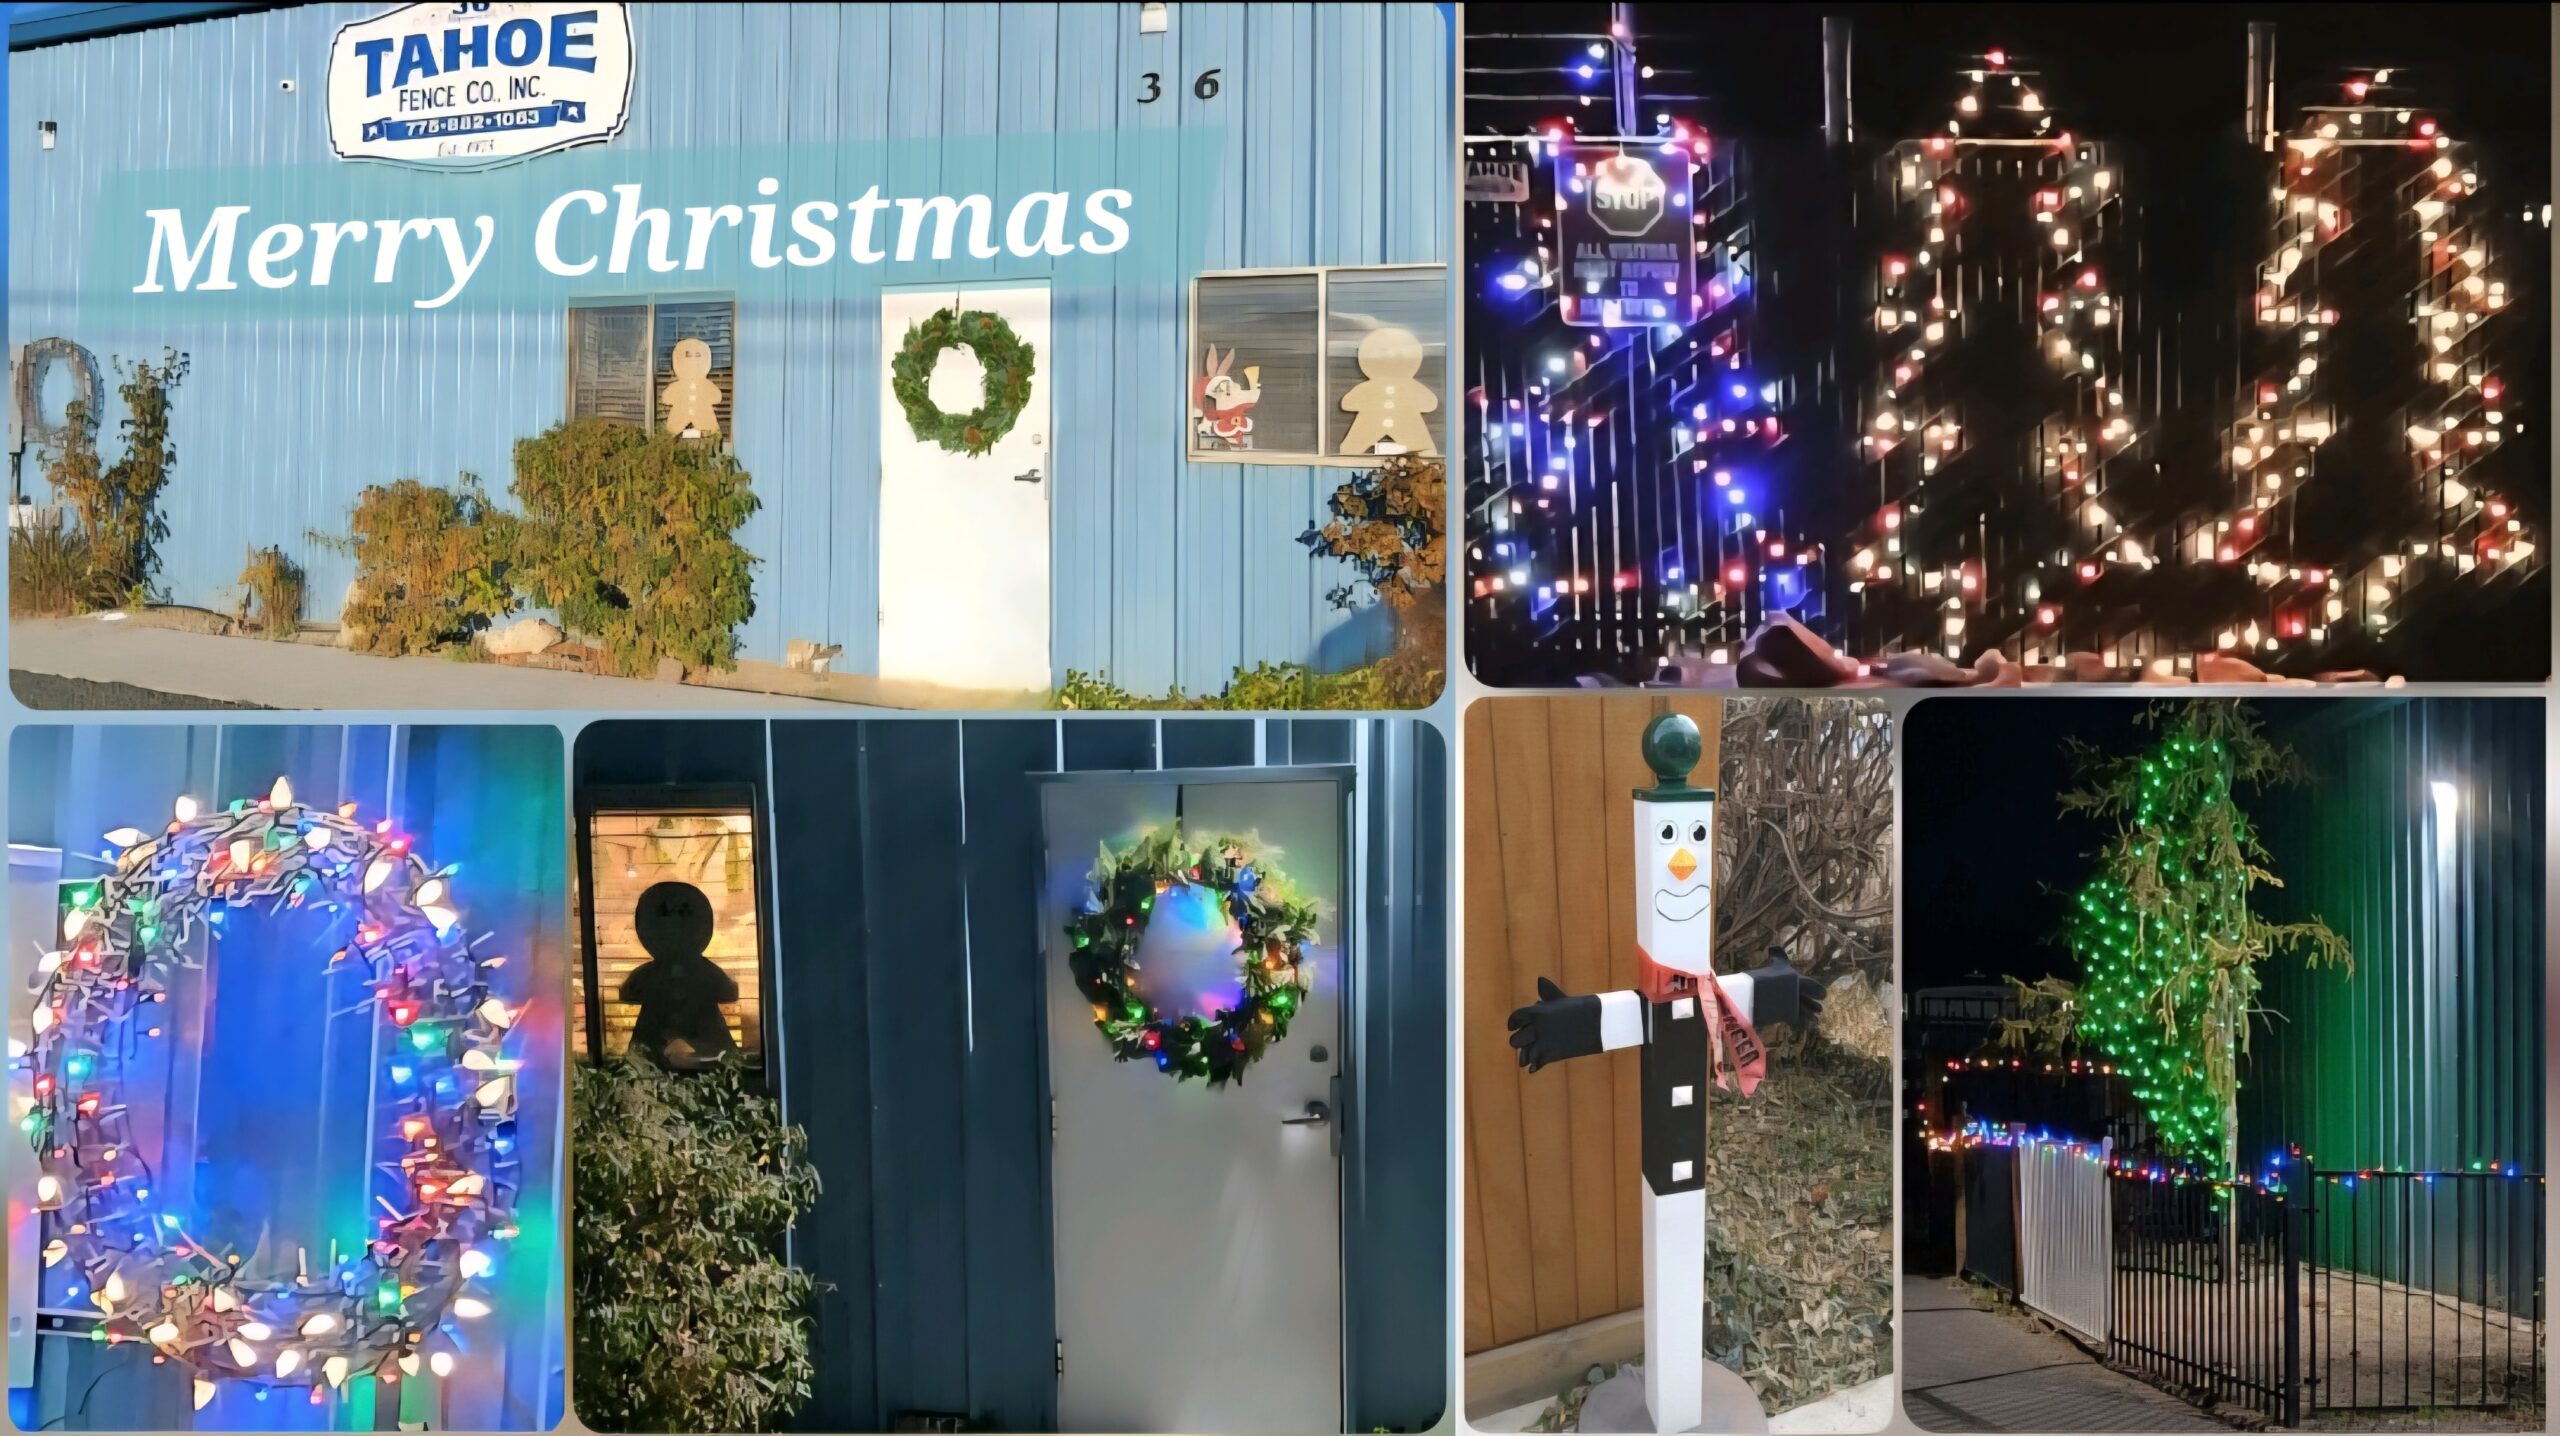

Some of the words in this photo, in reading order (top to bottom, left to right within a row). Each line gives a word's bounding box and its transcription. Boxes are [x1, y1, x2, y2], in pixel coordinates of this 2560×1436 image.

[355, 10, 598, 98] TAHOE
[399, 85, 456, 112] FENCE
[509, 75, 546, 101] INC.
[1596, 184, 1657, 210] STOP
